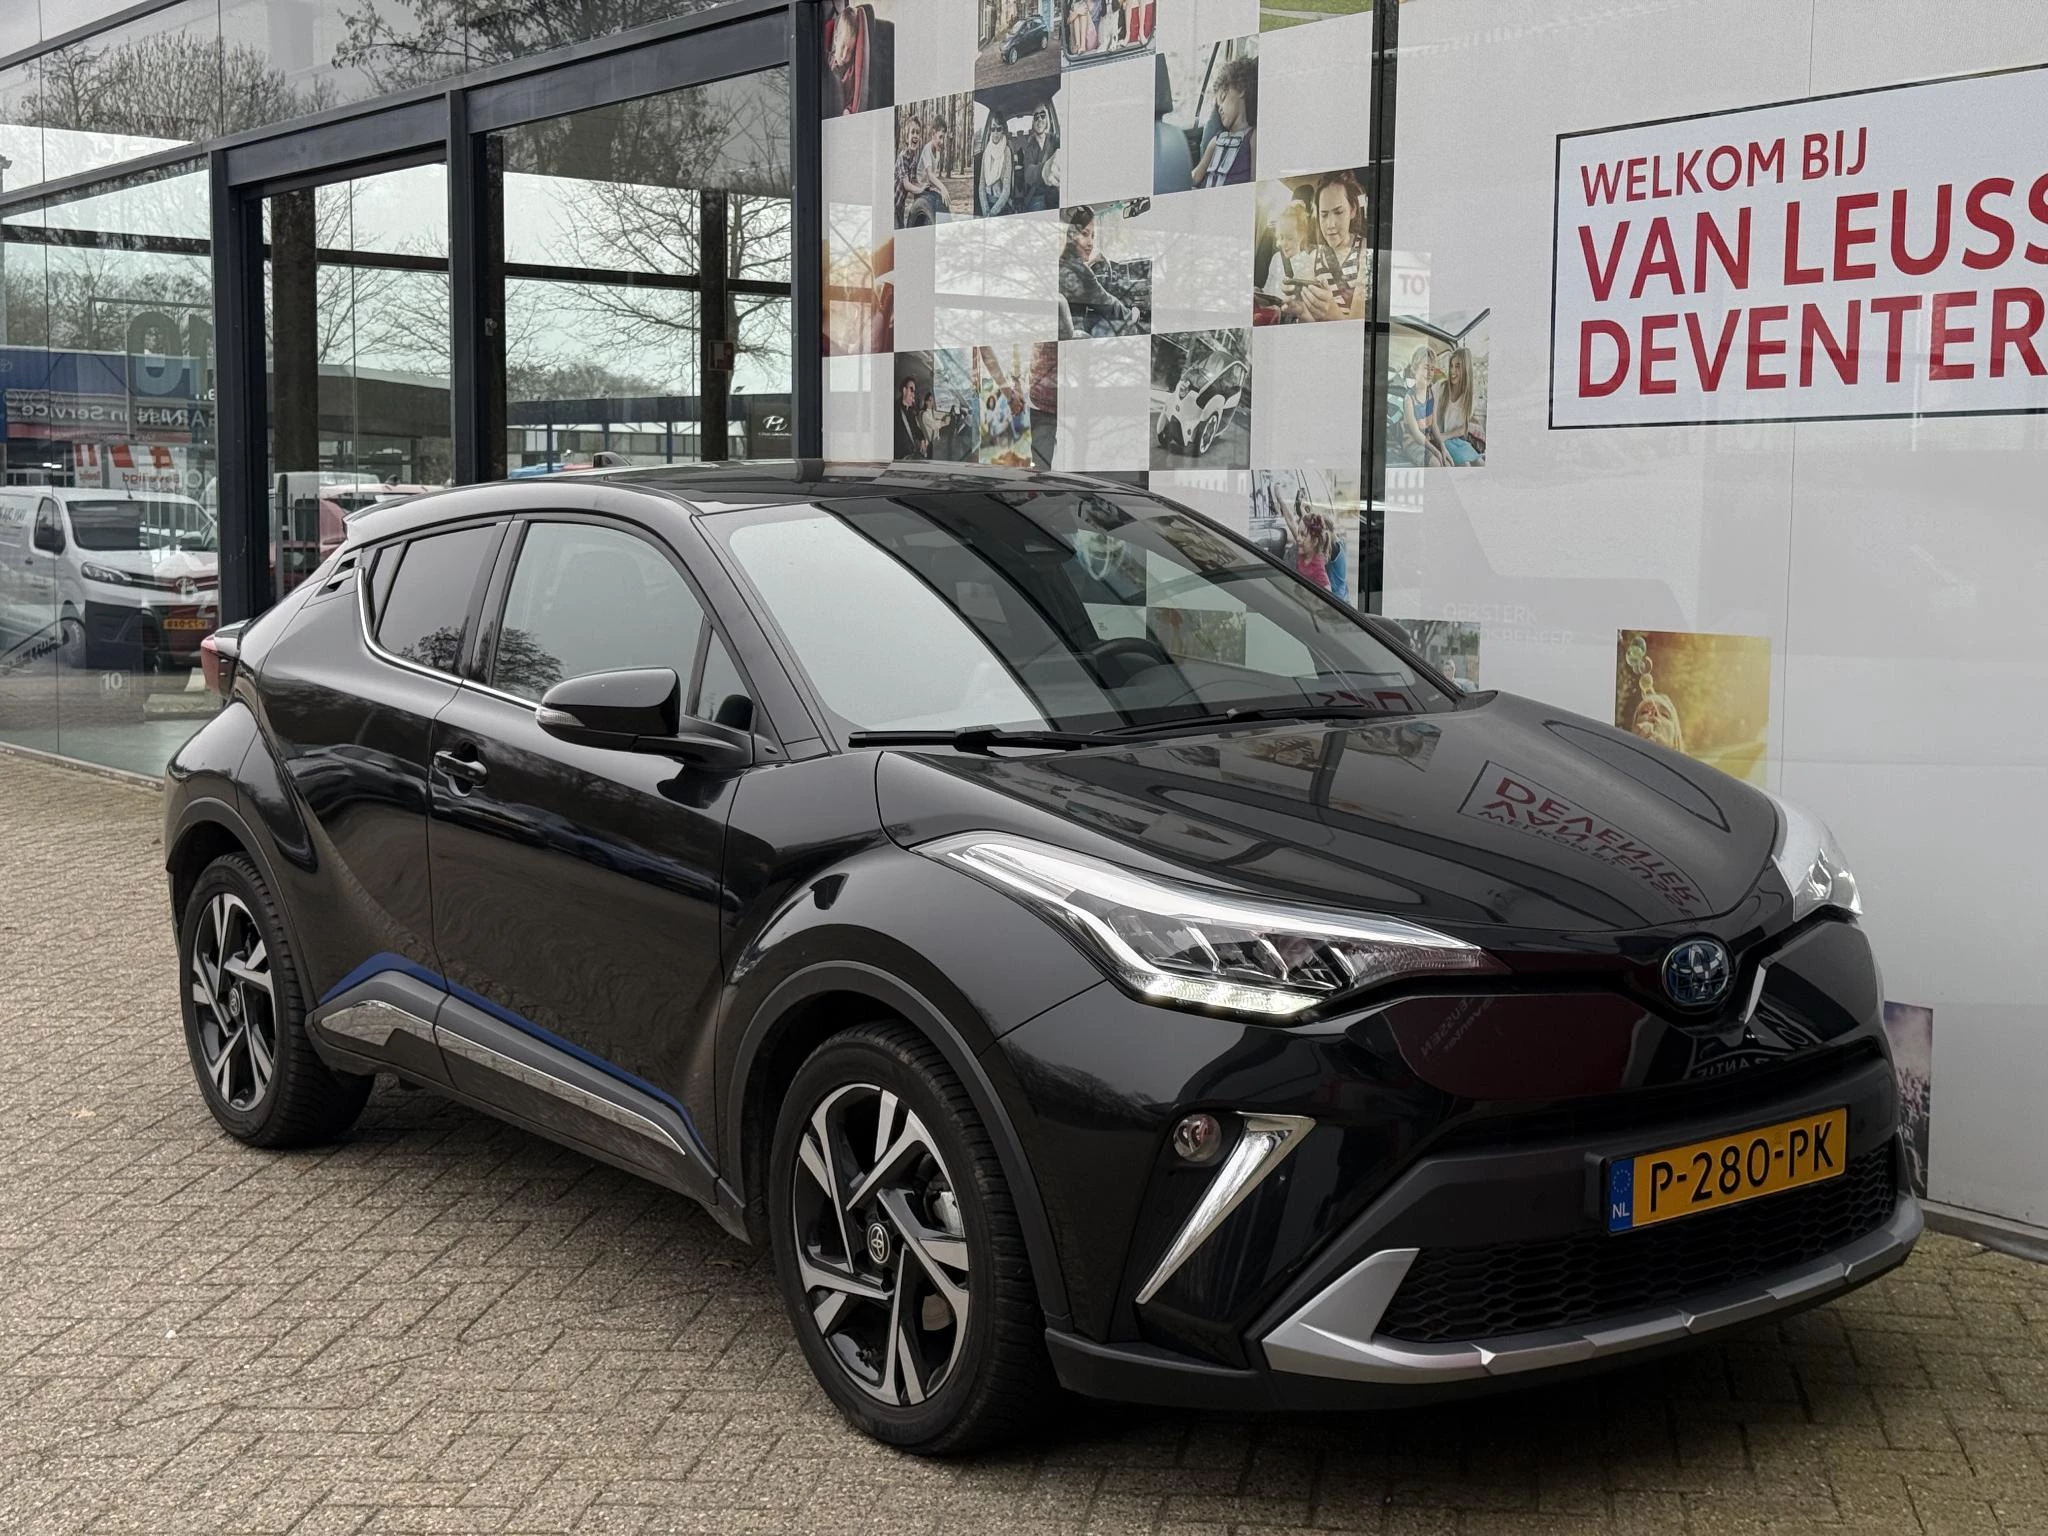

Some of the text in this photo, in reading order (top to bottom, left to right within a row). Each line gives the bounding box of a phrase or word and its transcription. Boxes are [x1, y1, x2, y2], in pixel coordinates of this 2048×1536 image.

[1580, 126, 1867, 207] WELKOM BIJ
[1577, 206, 1751, 302] VAN
[1578, 286, 2048, 398] DEVENTER
[102, 672, 123, 690] 10
[1649, 1120, 1834, 1212] P-280-PK
[1613, 1202, 1630, 1219] NL
